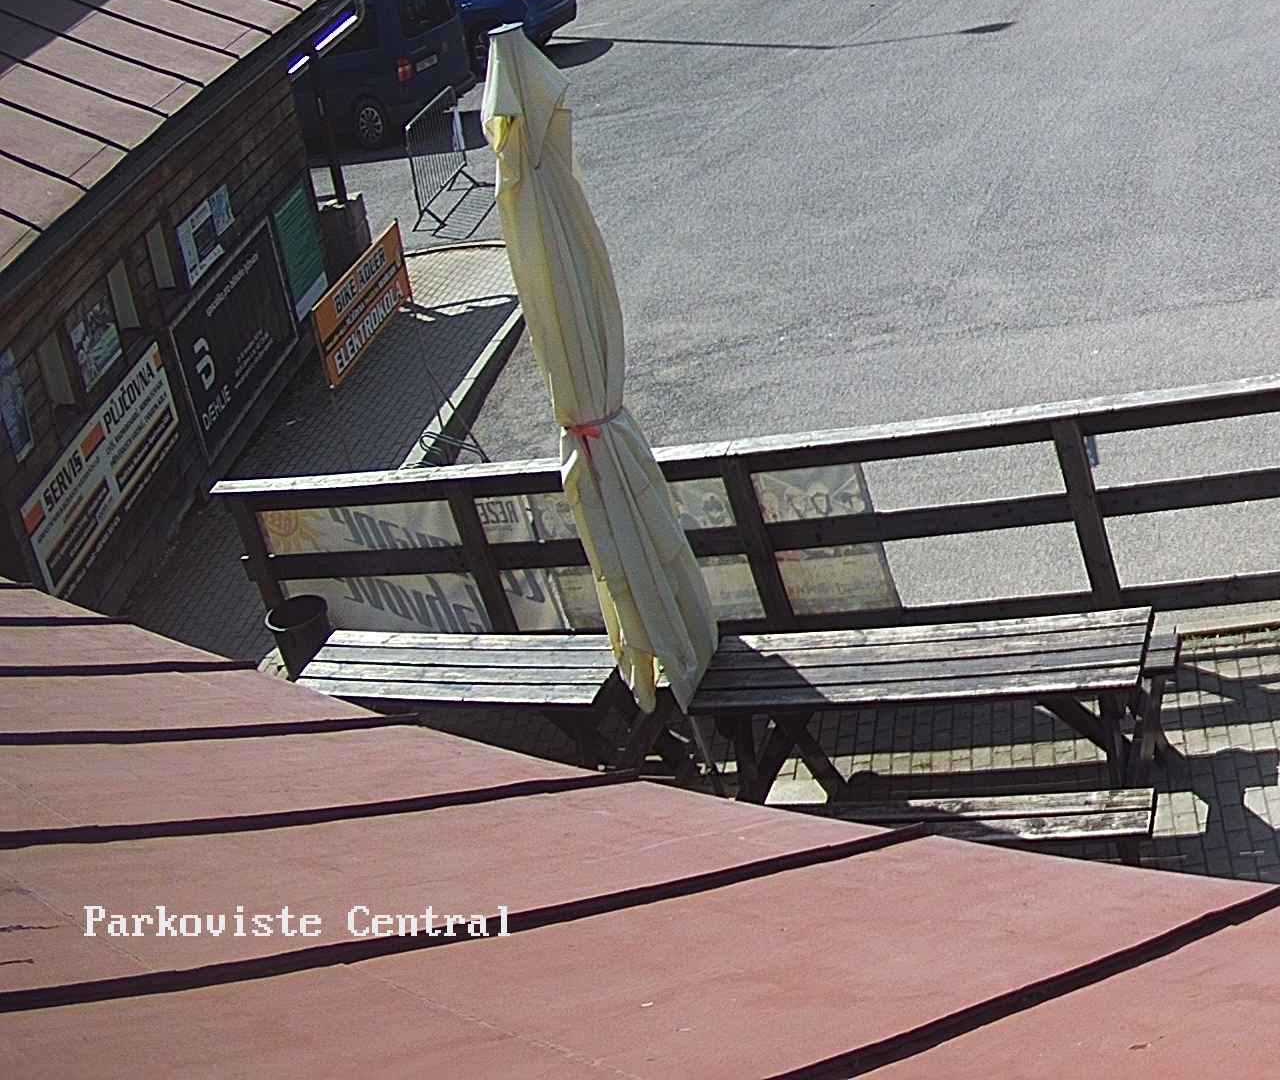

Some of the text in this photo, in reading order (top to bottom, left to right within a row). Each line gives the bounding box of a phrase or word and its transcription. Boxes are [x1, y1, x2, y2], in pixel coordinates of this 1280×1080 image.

[334, 247, 387, 316] BIKE ADLER
[334, 280, 404, 375] ELEKTROKOLA
[102, 360, 156, 434] PŮJČOVNA
[42, 450, 83, 509] SERVIS
